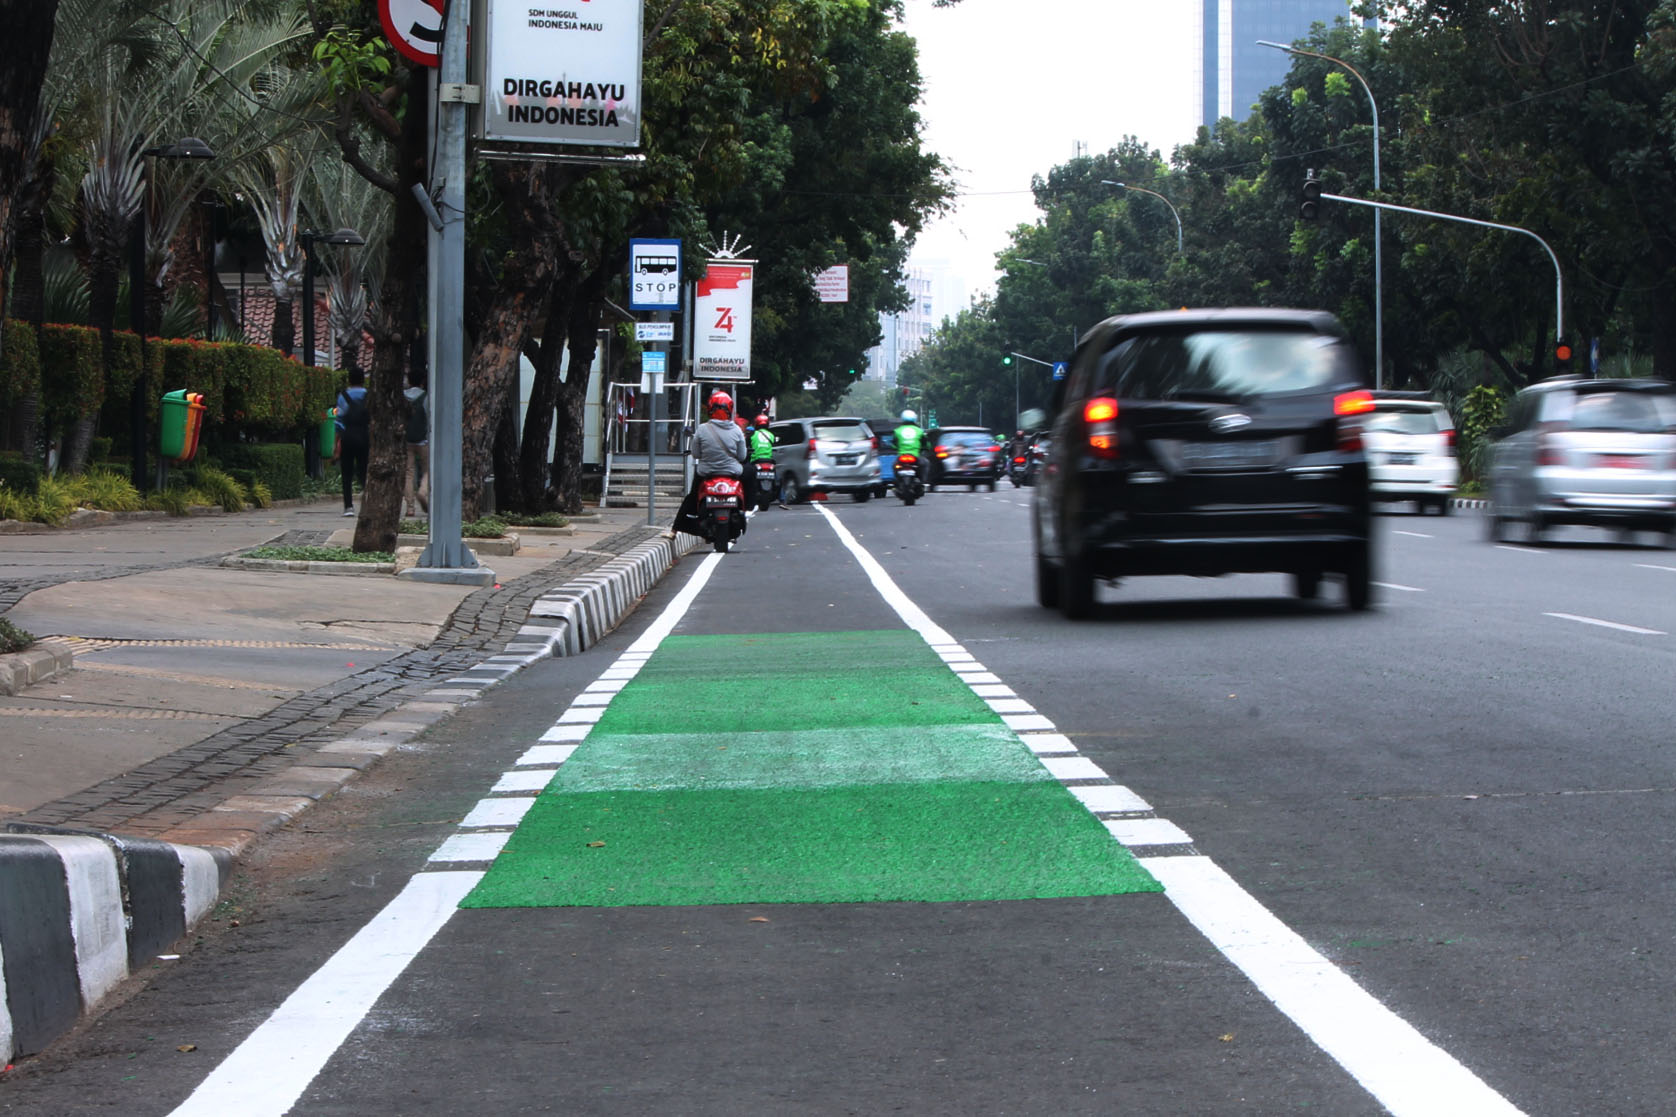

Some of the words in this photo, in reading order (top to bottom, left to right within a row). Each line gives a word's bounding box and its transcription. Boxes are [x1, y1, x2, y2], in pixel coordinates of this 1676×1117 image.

[528, 9, 545, 17] SDM
[546, 10, 578, 19] UNGGUL
[528, 19, 578, 30] INDONESIA
[580, 23, 603, 31] MAJU
[503, 78, 625, 102] DIRGAHAYU
[508, 105, 619, 127] INDONESIA
[635, 283, 676, 292] STOP
[699, 357, 745, 365] DIRGAHAYU
[700, 365, 743, 373] INDONESIA
